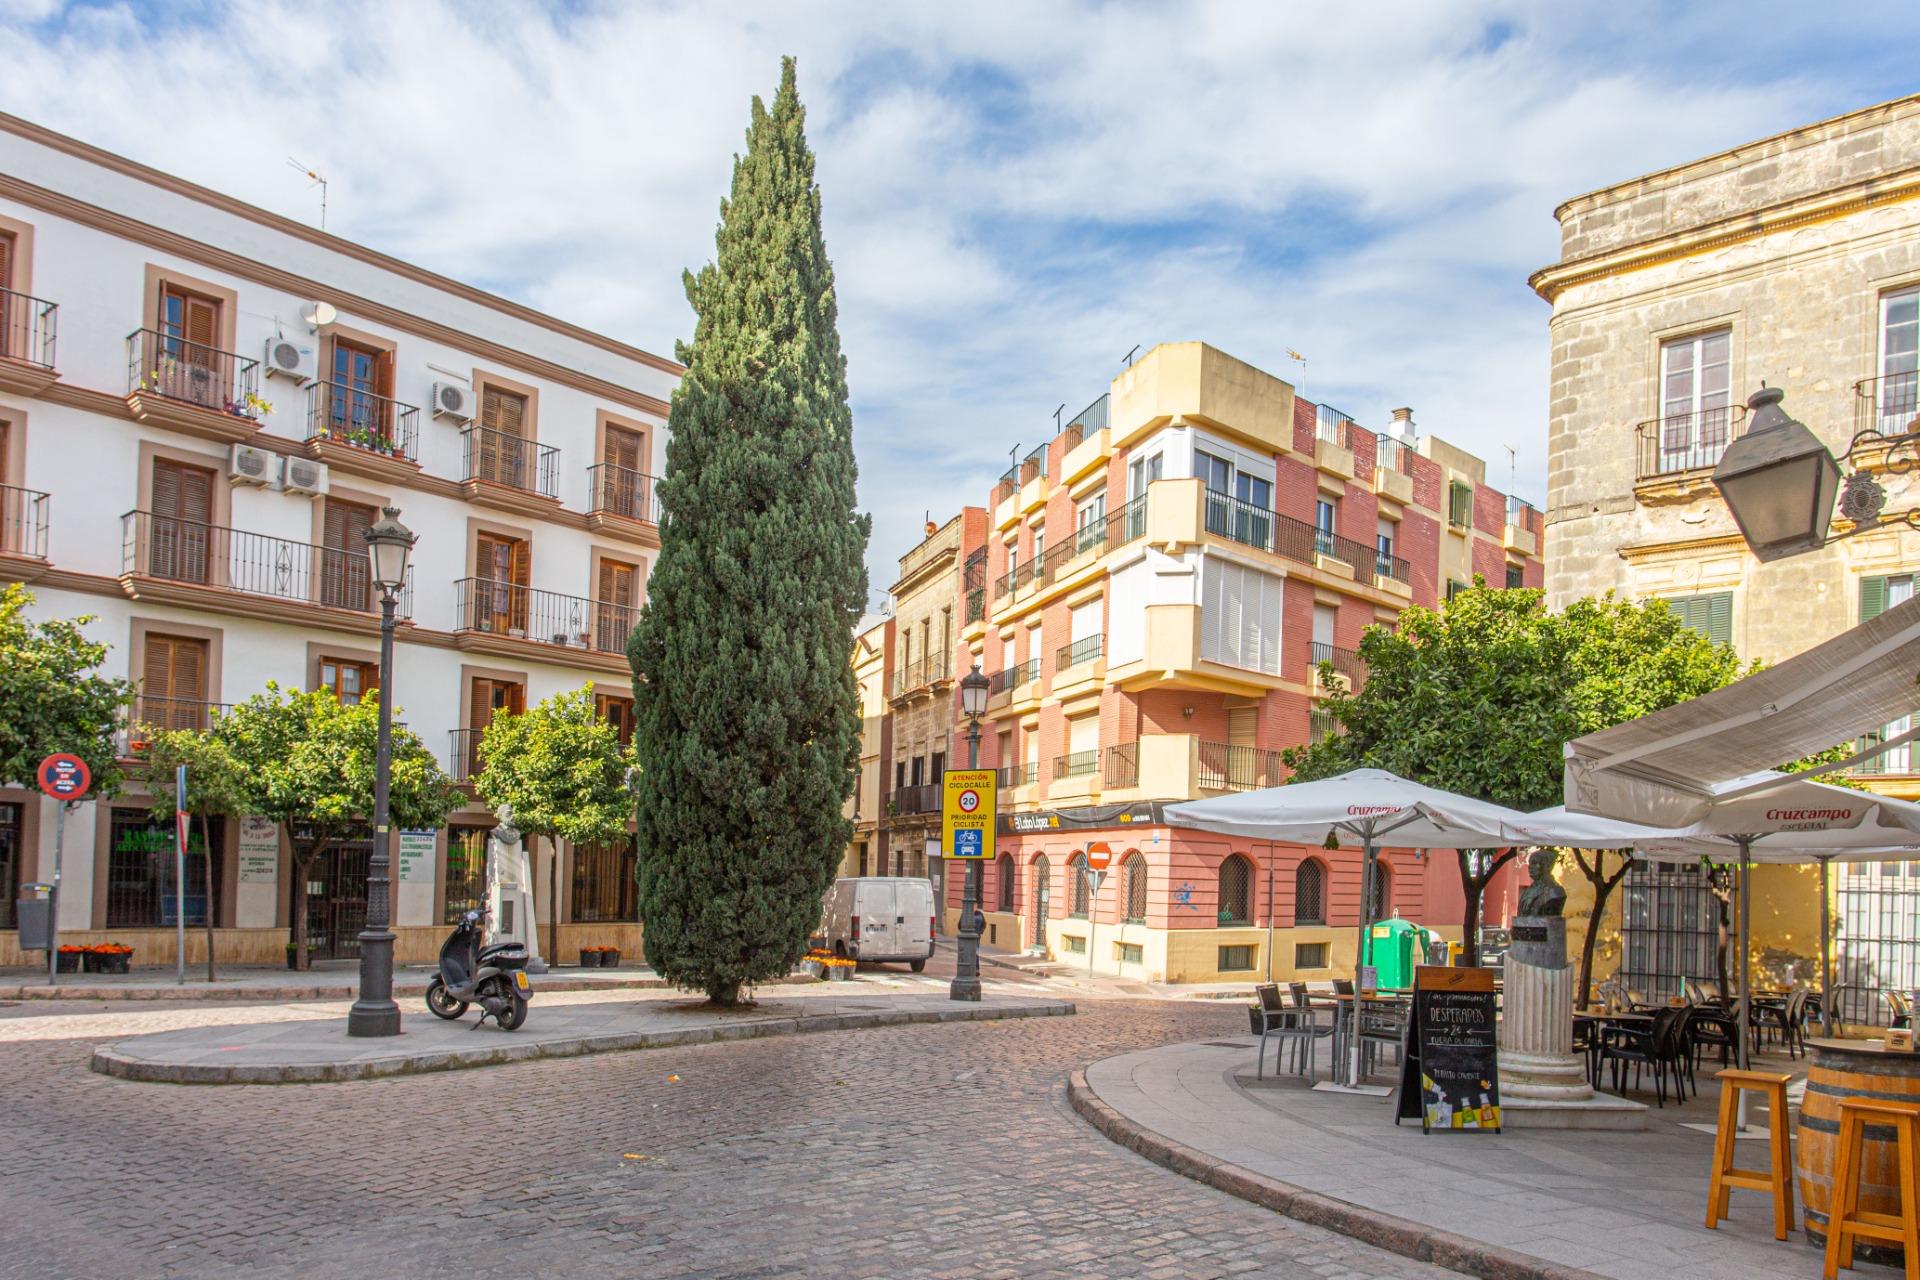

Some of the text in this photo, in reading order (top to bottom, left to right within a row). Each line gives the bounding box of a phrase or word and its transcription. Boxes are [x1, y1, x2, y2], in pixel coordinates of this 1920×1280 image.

[962, 797, 975, 805] 20
[1766, 808, 1852, 820] Cruzcampo
[1430, 1007, 1485, 1023] DESPERADOS
